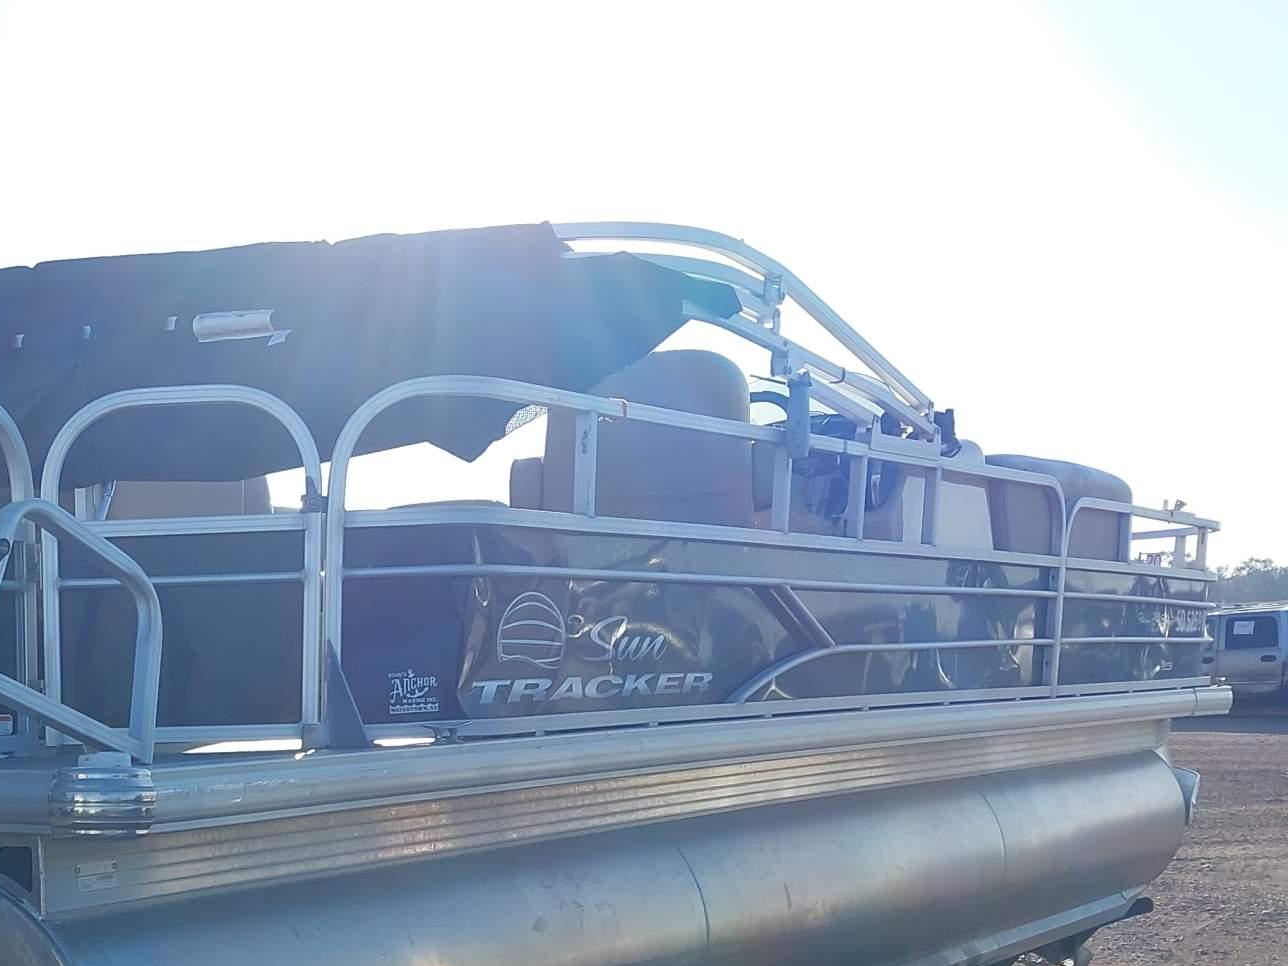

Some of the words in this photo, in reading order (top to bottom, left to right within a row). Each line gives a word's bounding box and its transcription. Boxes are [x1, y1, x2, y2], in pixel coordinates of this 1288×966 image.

[580, 615, 668, 662] Sun
[390, 676, 438, 703] ANCHOR
[472, 672, 714, 704] TRACKER
